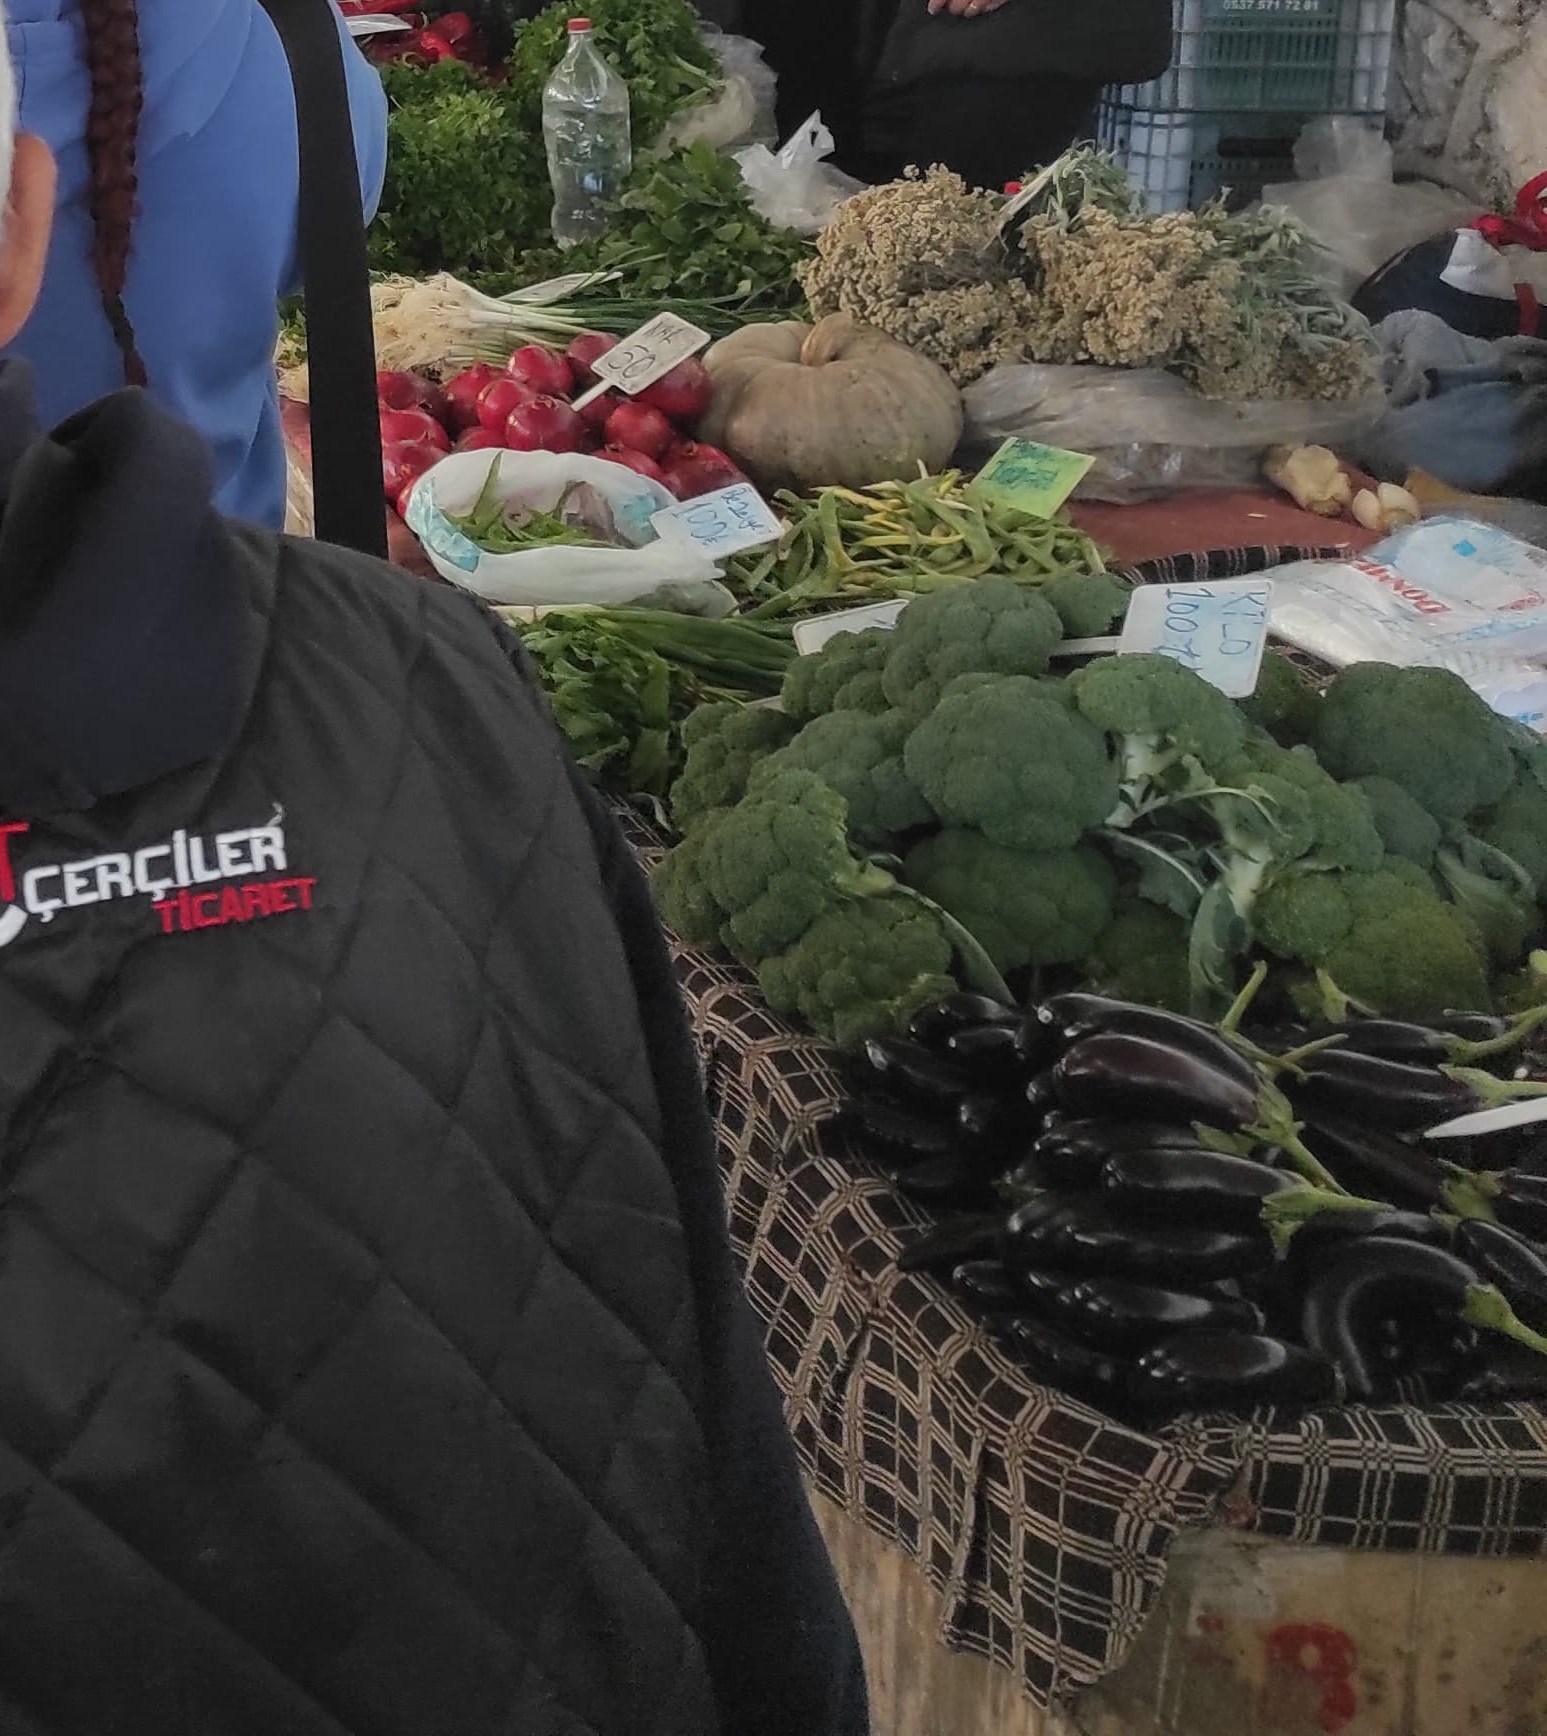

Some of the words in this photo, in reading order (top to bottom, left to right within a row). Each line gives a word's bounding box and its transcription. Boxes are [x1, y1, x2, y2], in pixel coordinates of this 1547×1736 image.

[608, 344, 657, 379] 50
[22, 825, 288, 924] ÇERÇİLER
[153, 876, 317, 934] TİCARET
